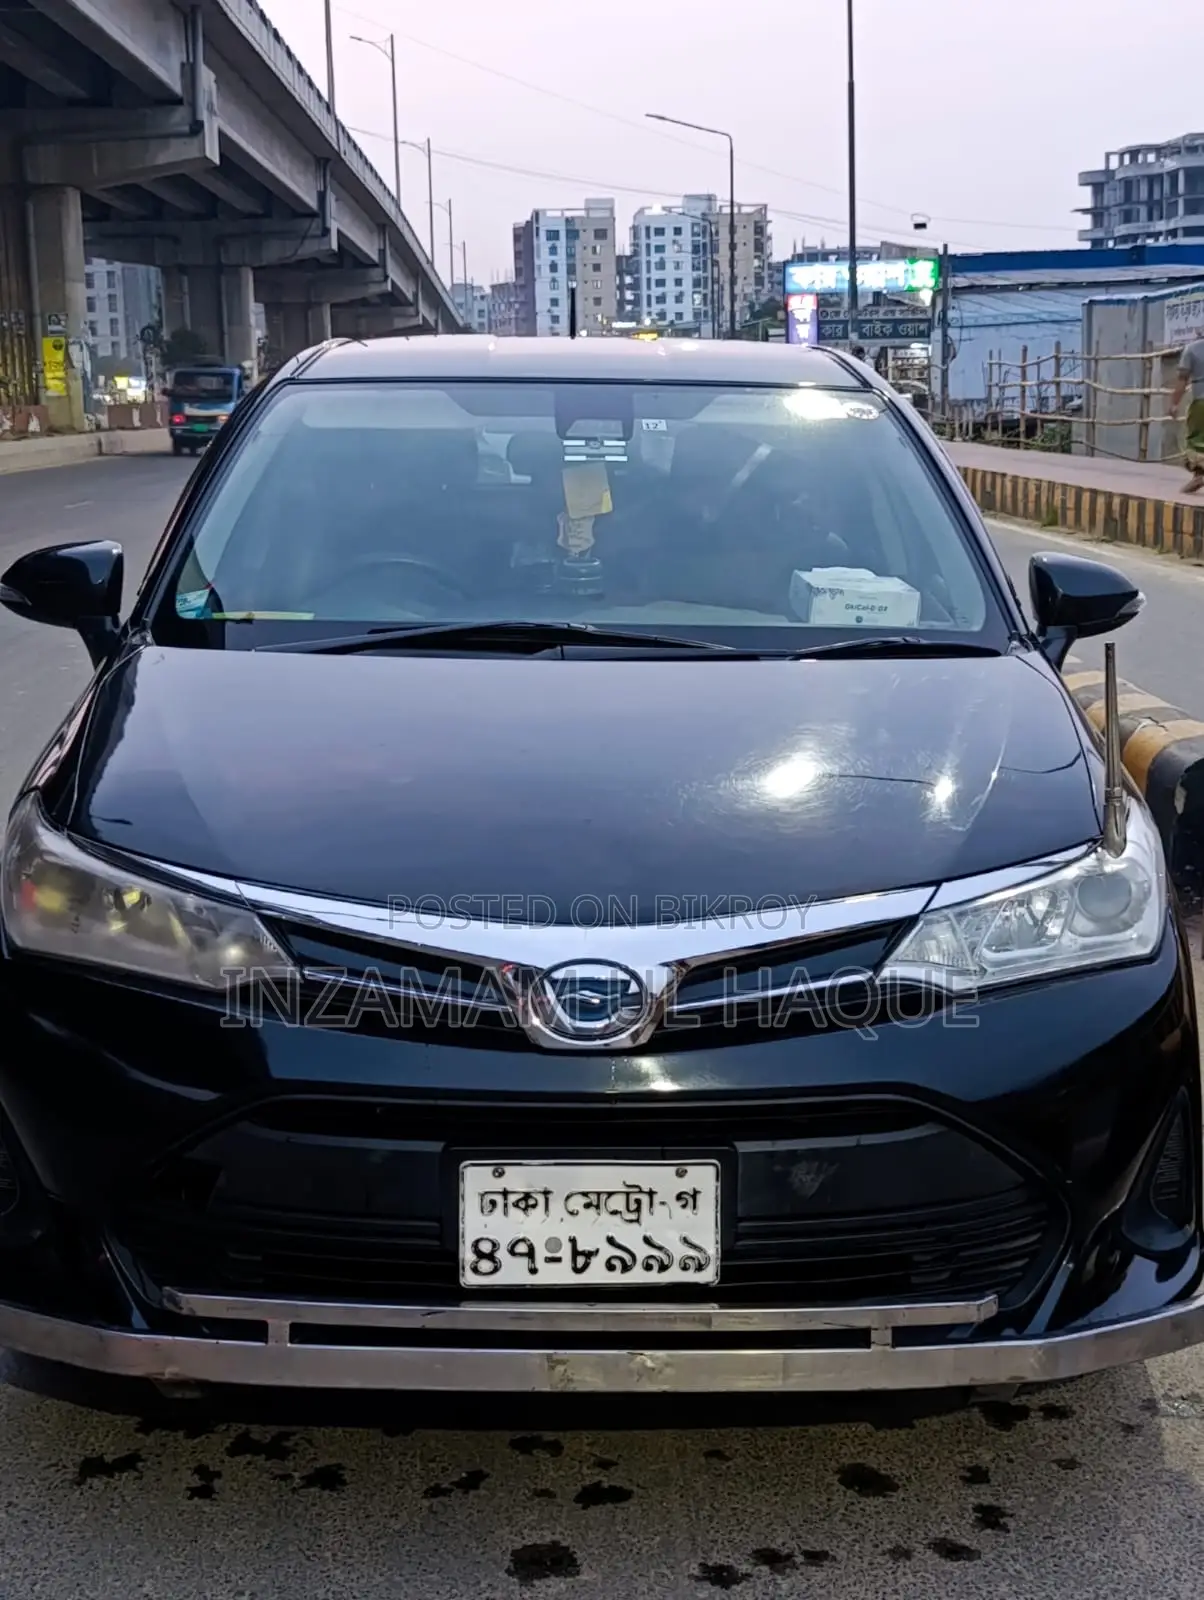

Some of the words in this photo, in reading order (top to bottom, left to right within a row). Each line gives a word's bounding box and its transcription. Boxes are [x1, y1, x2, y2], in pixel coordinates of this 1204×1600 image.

[861, 320, 893, 338] বাইক
[898, 323, 929, 338] ওয়াশ
[477, 1186, 554, 1218] ঢাকা
[469, 1234, 711, 1277] ৪৭-৮৯৯৯
